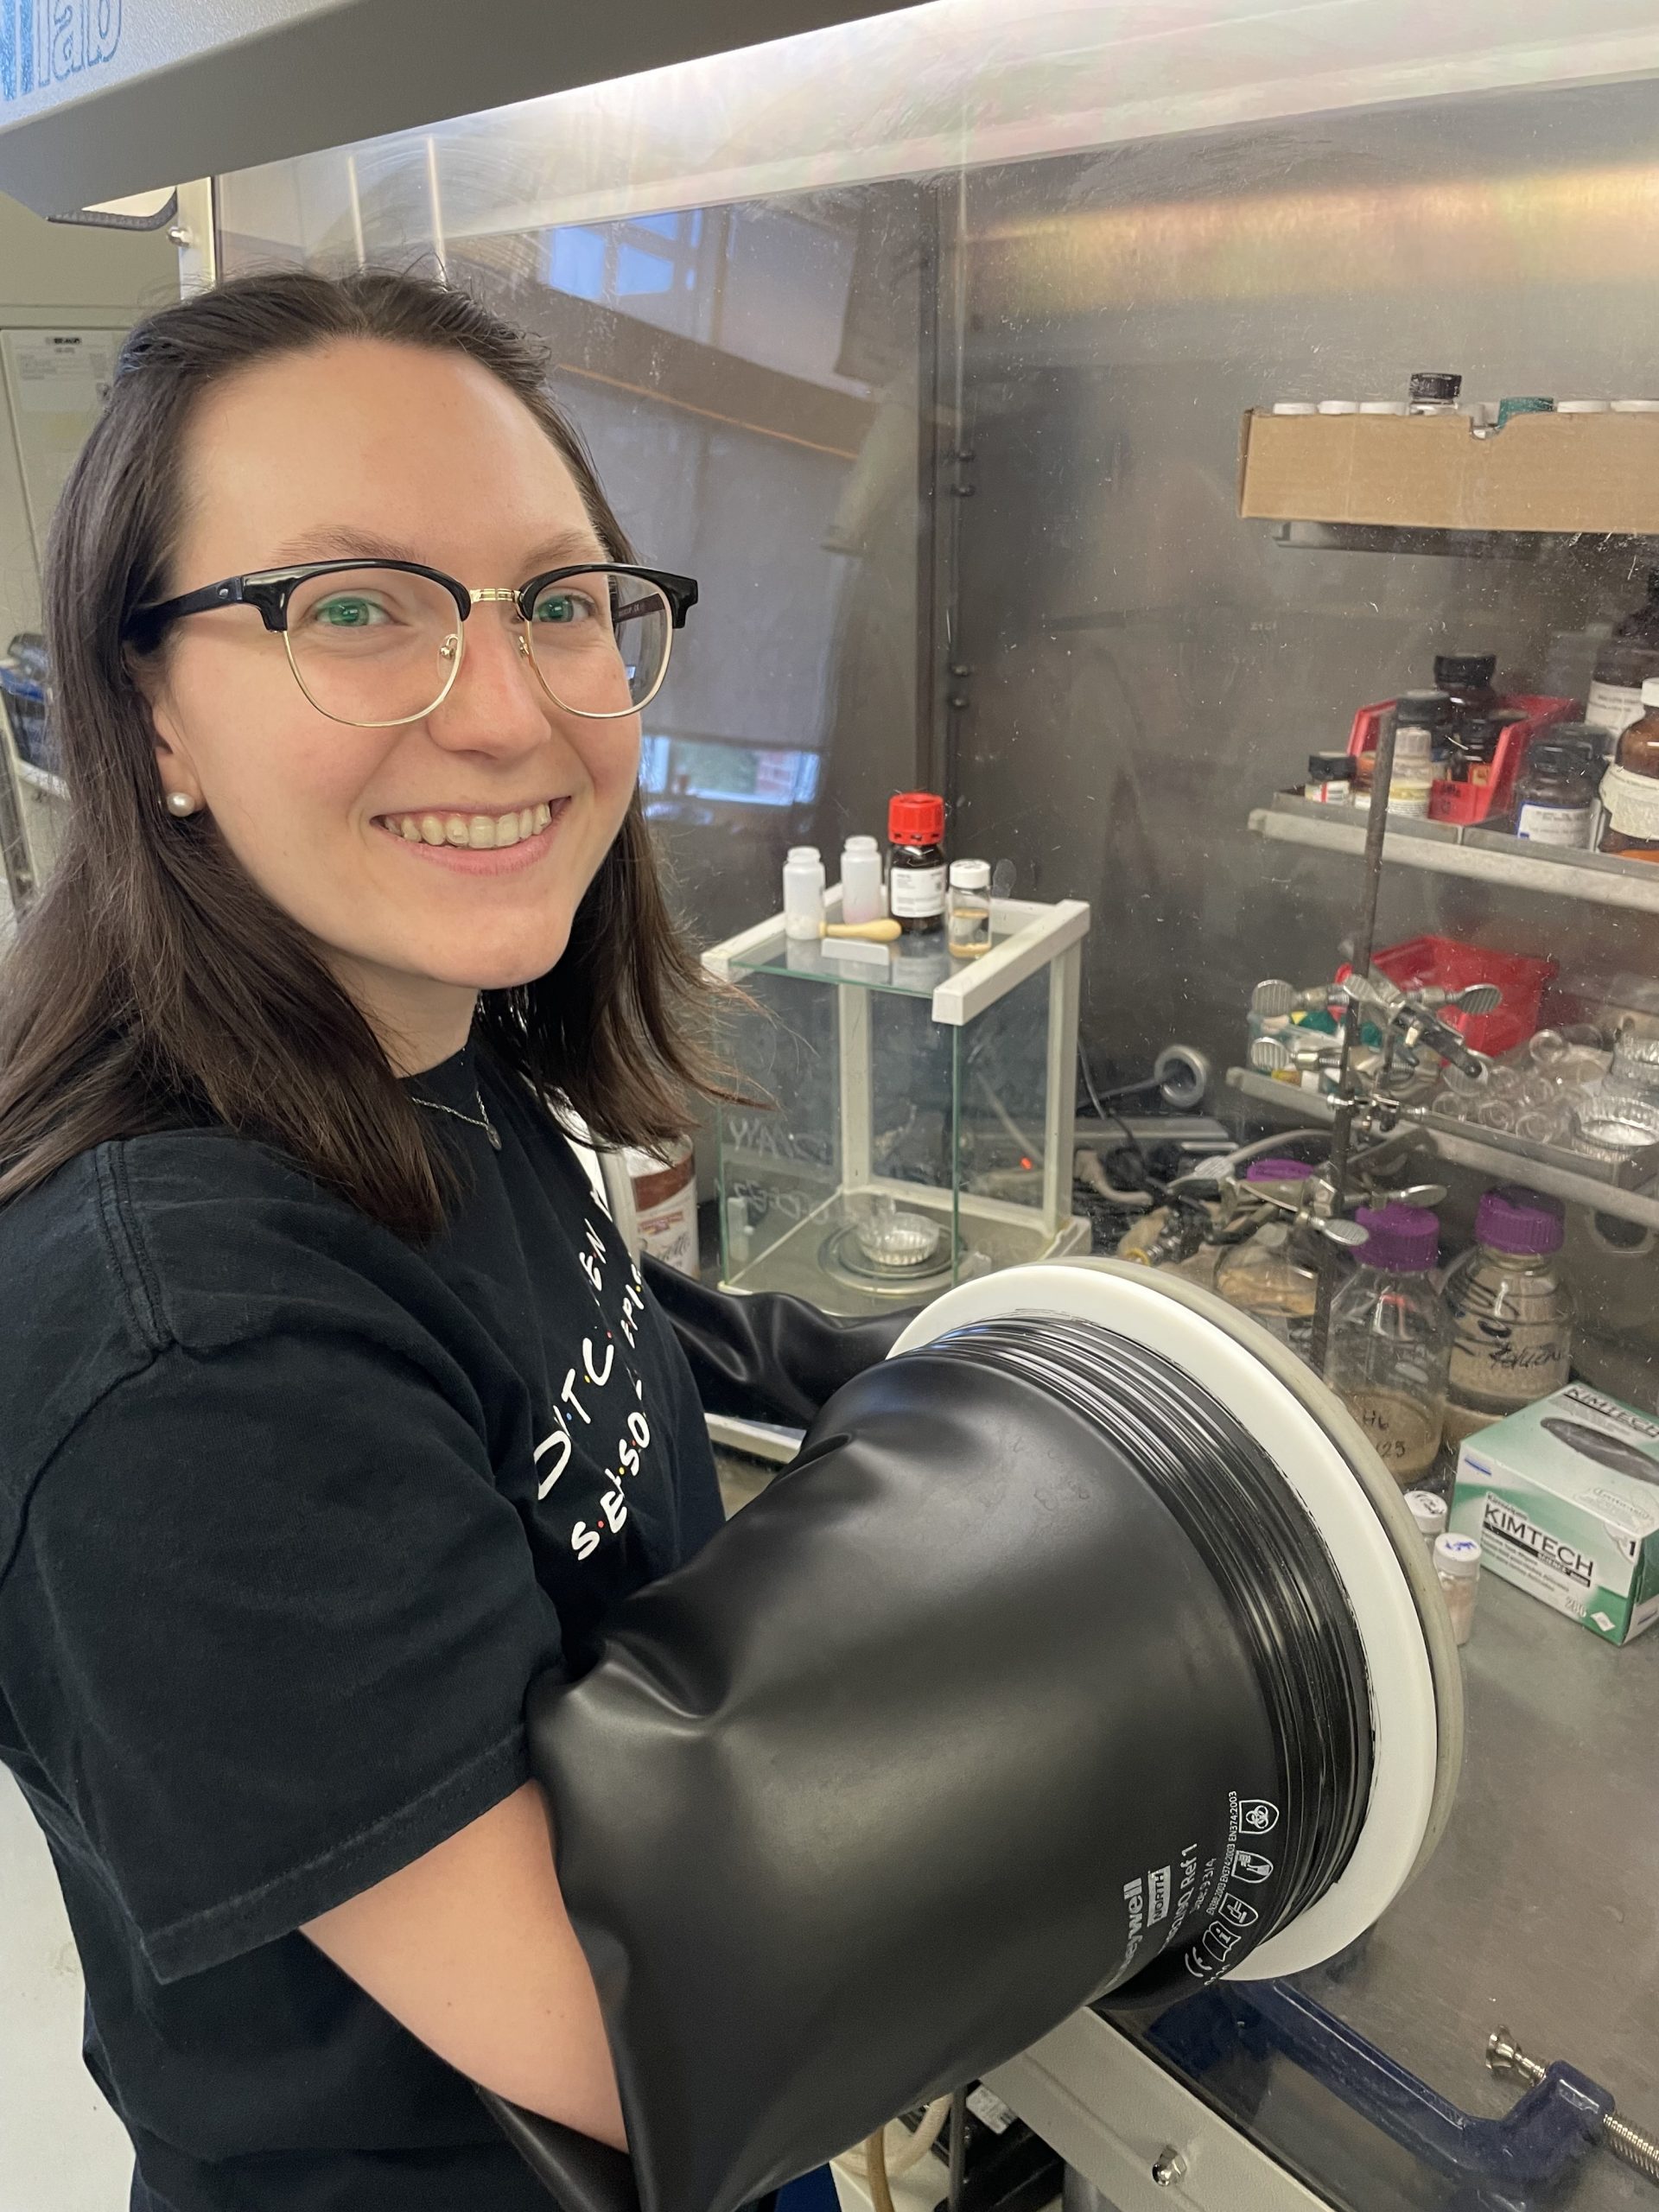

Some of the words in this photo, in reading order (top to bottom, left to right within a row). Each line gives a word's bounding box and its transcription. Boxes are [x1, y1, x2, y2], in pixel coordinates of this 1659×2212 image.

[1484, 1503, 1594, 1577] KIMTECH
[1228, 1790, 1237, 1841] EN374:2003
[1153, 1872, 1165, 1920] NORTH
[1180, 1858, 1198, 1890] Ref
